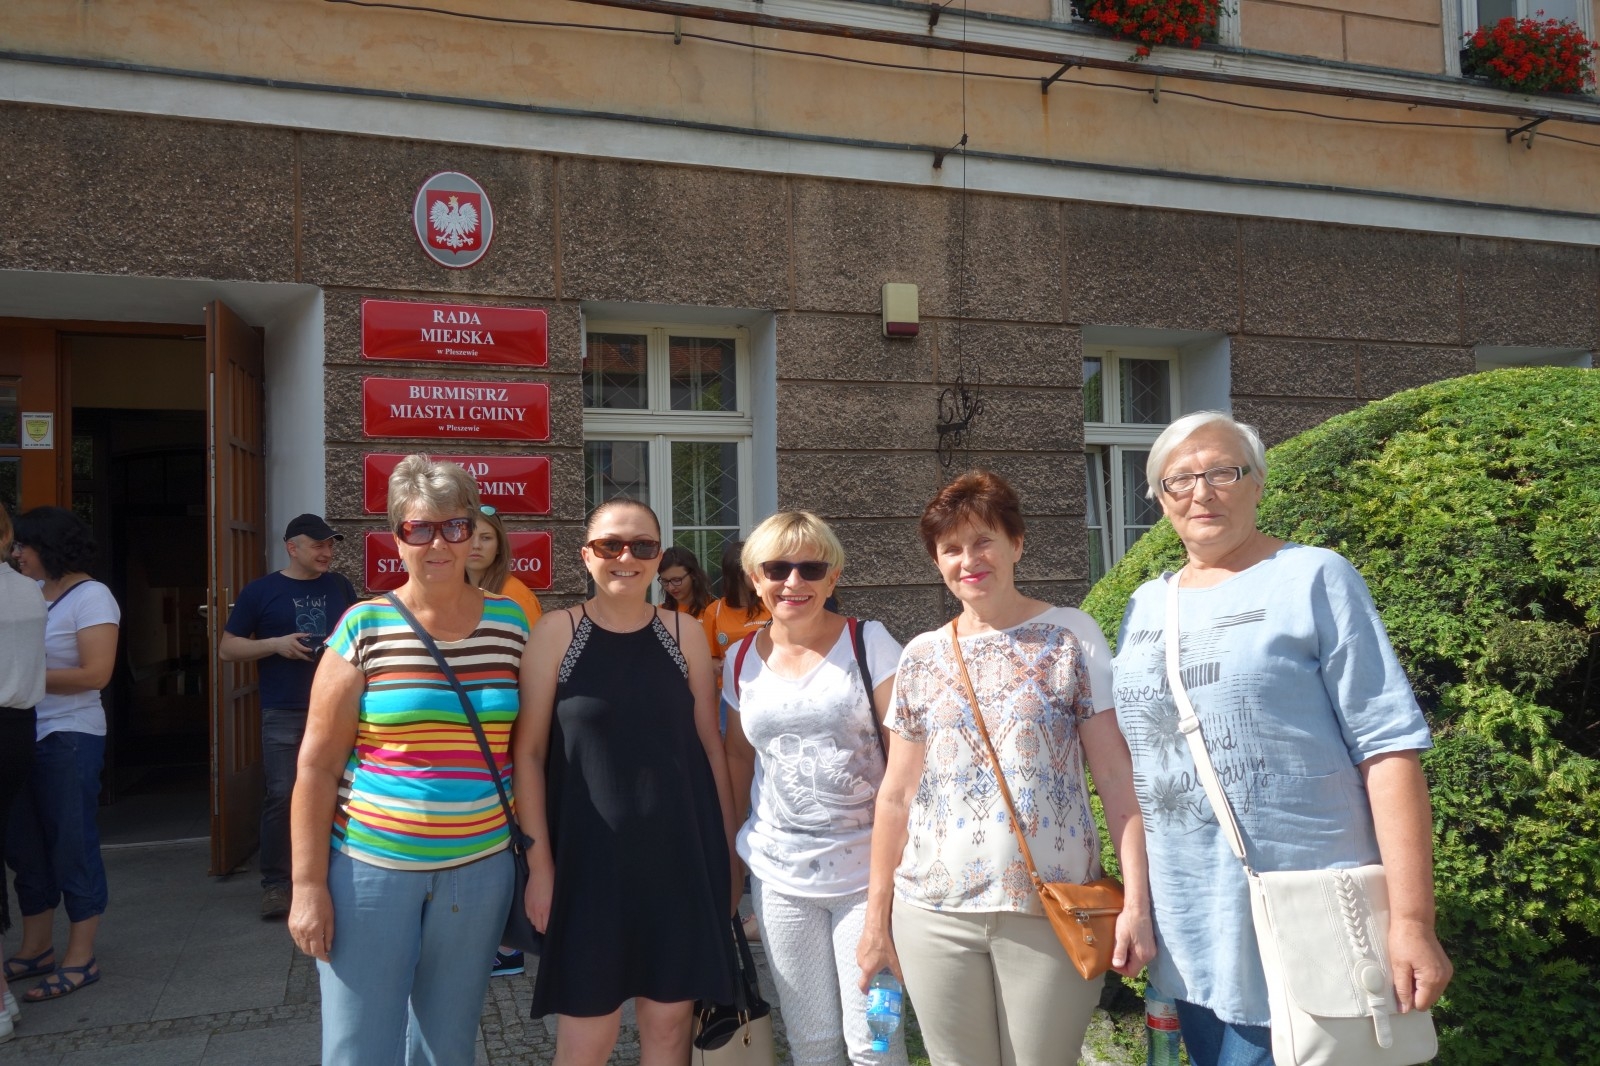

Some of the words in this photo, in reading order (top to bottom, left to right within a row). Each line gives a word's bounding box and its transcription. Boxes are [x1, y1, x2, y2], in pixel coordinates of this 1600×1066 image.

[432, 309, 482, 325] RADA
[420, 328, 495, 346] MIEJSKA
[445, 348, 479, 356] Pleszewie
[409, 385, 508, 402] BURMISTRZ
[389, 404, 455, 420] MIASTA
[459, 406, 465, 420] I
[469, 406, 527, 421] GMINY
[446, 424, 480, 432] Pleszewie
